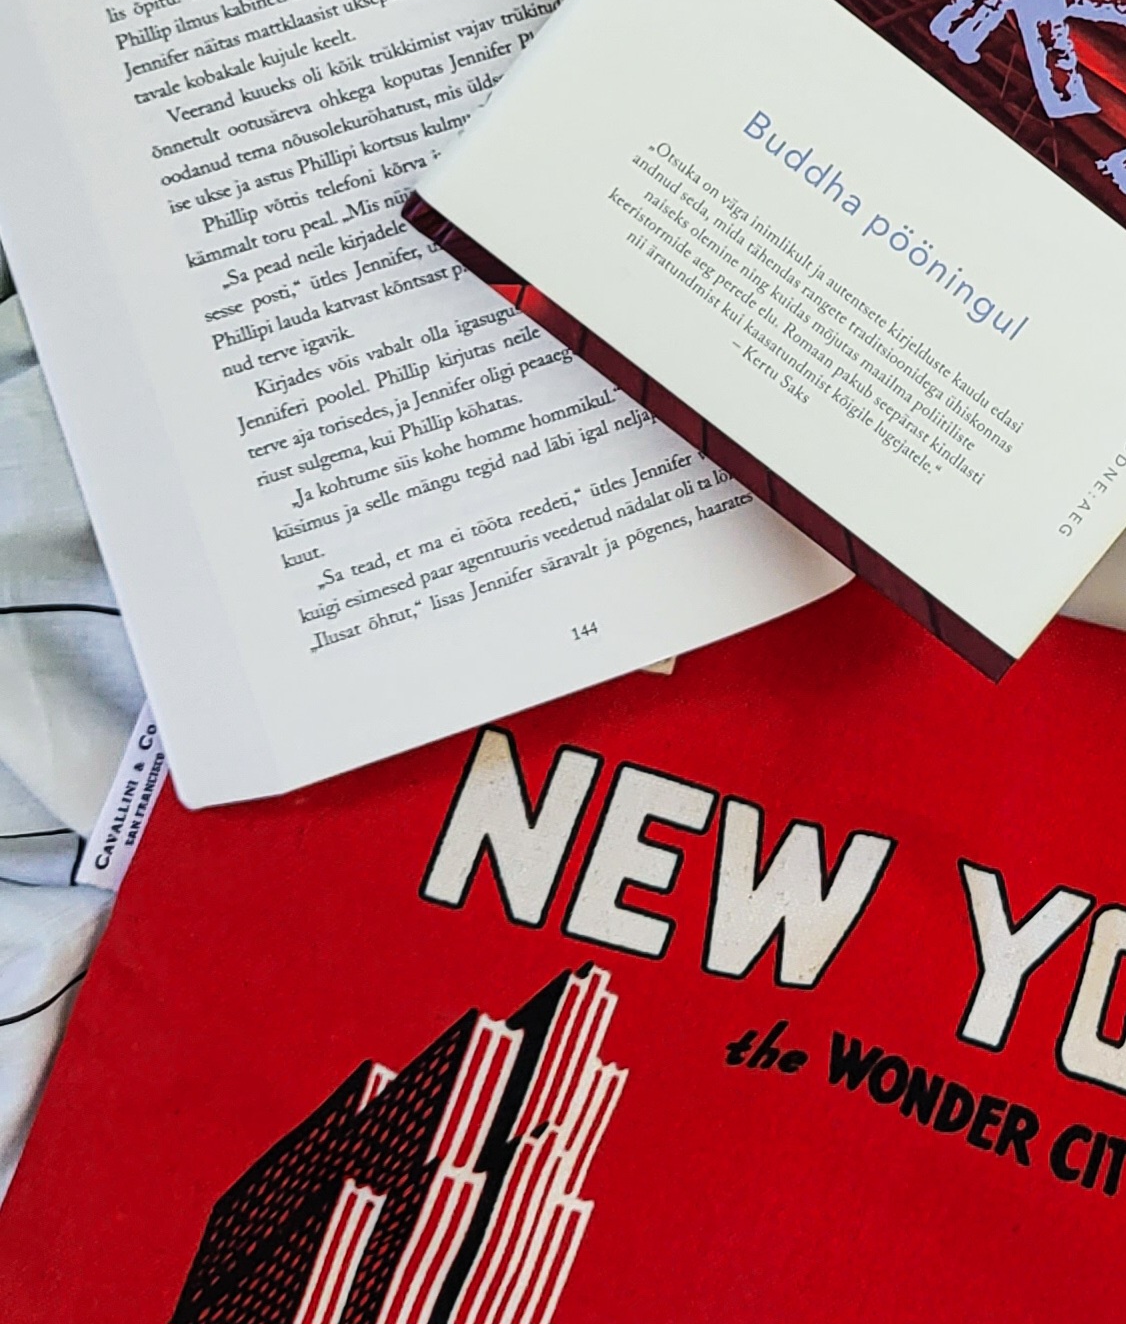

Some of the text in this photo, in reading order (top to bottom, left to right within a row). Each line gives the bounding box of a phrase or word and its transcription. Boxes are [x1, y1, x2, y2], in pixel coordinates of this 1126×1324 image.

[115, 25, 172, 50] Phillip
[174, 12, 220, 33] ilmus
[632, 155, 1012, 453] andnud seda, mida tähendas rangete traditsioonidega ühiskonnas
[702, 182, 719, 198] on
[721, 195, 749, 222] väga
[749, 215, 813, 270] inimlikult
[808, 264, 825, 281] ja
[826, 278, 887, 328] autentsete
[887, 321, 951, 378] kirjelduste
[951, 371, 989, 408] kaudu
[990, 406, 1024, 434] edasi
[742, 110, 1029, 341] Buddha pööningul
[608, 187, 985, 485] keeristormide aeg perede elu. Romaan pakub seepärast kindlasti
[626, 233, 648, 250] nii
[646, 245, 721, 308] äratundmist
[721, 301, 745, 326] kui
[743, 319, 832, 394] kaasatundmist
[831, 387, 874, 426] kõigile
[643, 191, 975, 451] naiseks olemine ning kuidas mõjutas maailma poliitiliste
[742, 345, 779, 380] Kertu
[779, 374, 810, 403] Saks
[281, 548, 325, 569] kuut.
[429, 591, 465, 610] lisas
[469, 566, 533, 602] Jennifer
[540, 543, 599, 573] säravalt
[604, 538, 620, 558] ja
[625, 516, 693, 550] põgenes,
[695, 492, 754, 522] haarates
[571, 621, 598, 640] 144
[95, 780, 138, 870] CAVALLINI
[134, 762, 145, 772] &
[419, 725, 894, 989] NEW
[725, 1020, 807, 1075] the
[828, 1031, 1038, 1166] WONDER
